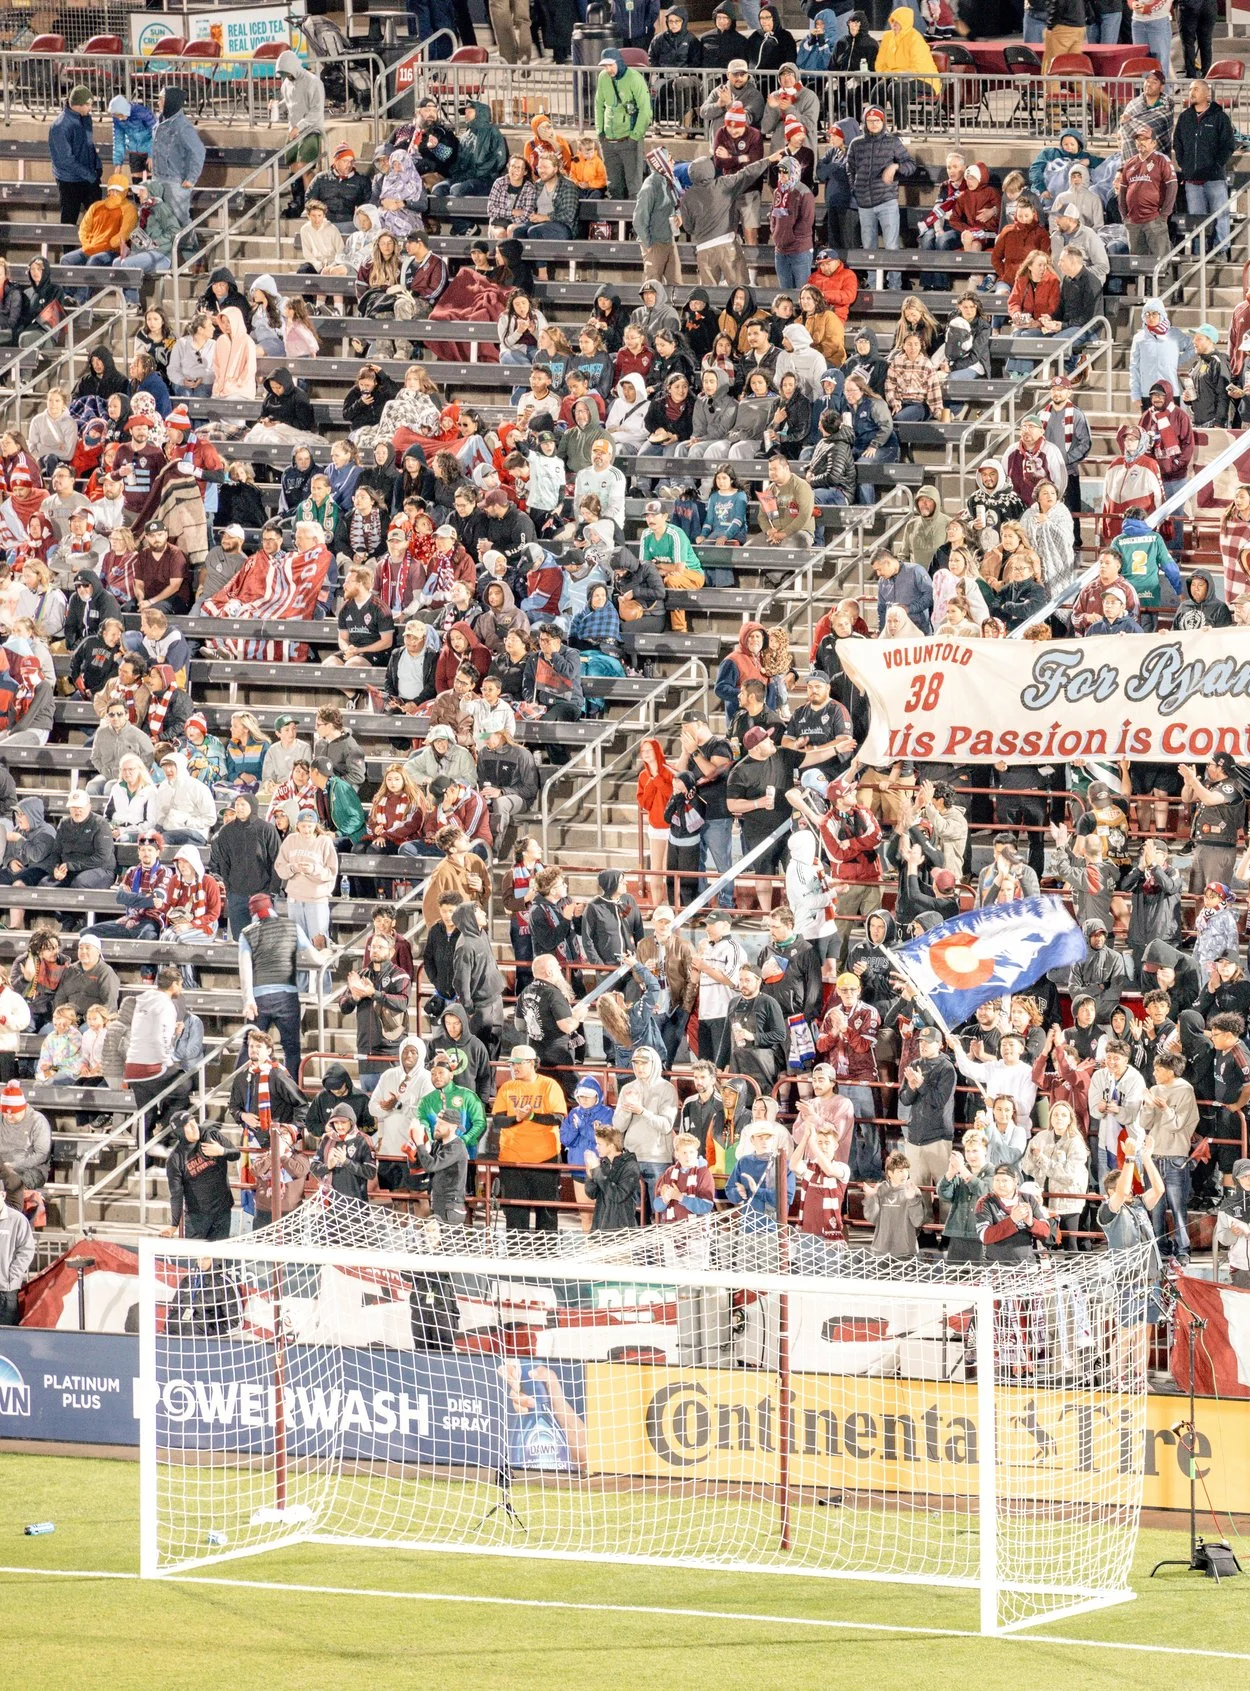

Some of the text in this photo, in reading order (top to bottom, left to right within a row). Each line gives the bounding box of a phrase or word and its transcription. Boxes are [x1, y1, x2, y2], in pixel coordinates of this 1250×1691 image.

[150, 28, 165, 37] SUN
[228, 19, 286, 38] REAL ICED TEA.
[229, 38, 247, 52] REAL
[399, 67, 413, 82] 116
[1131, 550, 1149, 575] 2
[883, 643, 973, 670] VOLUNTOLD
[1020, 648, 1117, 711] For
[904, 671, 945, 713] 38
[941, 721, 1109, 758] Passion
[1114, 719, 1153, 756] is
[43, 1374, 120, 1393] PLATINUM
[62, 1393, 101, 1410] PLUS
[448, 1398, 482, 1414] DISH
[442, 1415, 489, 1432] SPRAY
[646, 1382, 1212, 1479] Continenta Tire
[530, 1444, 556, 1455] DAWN
